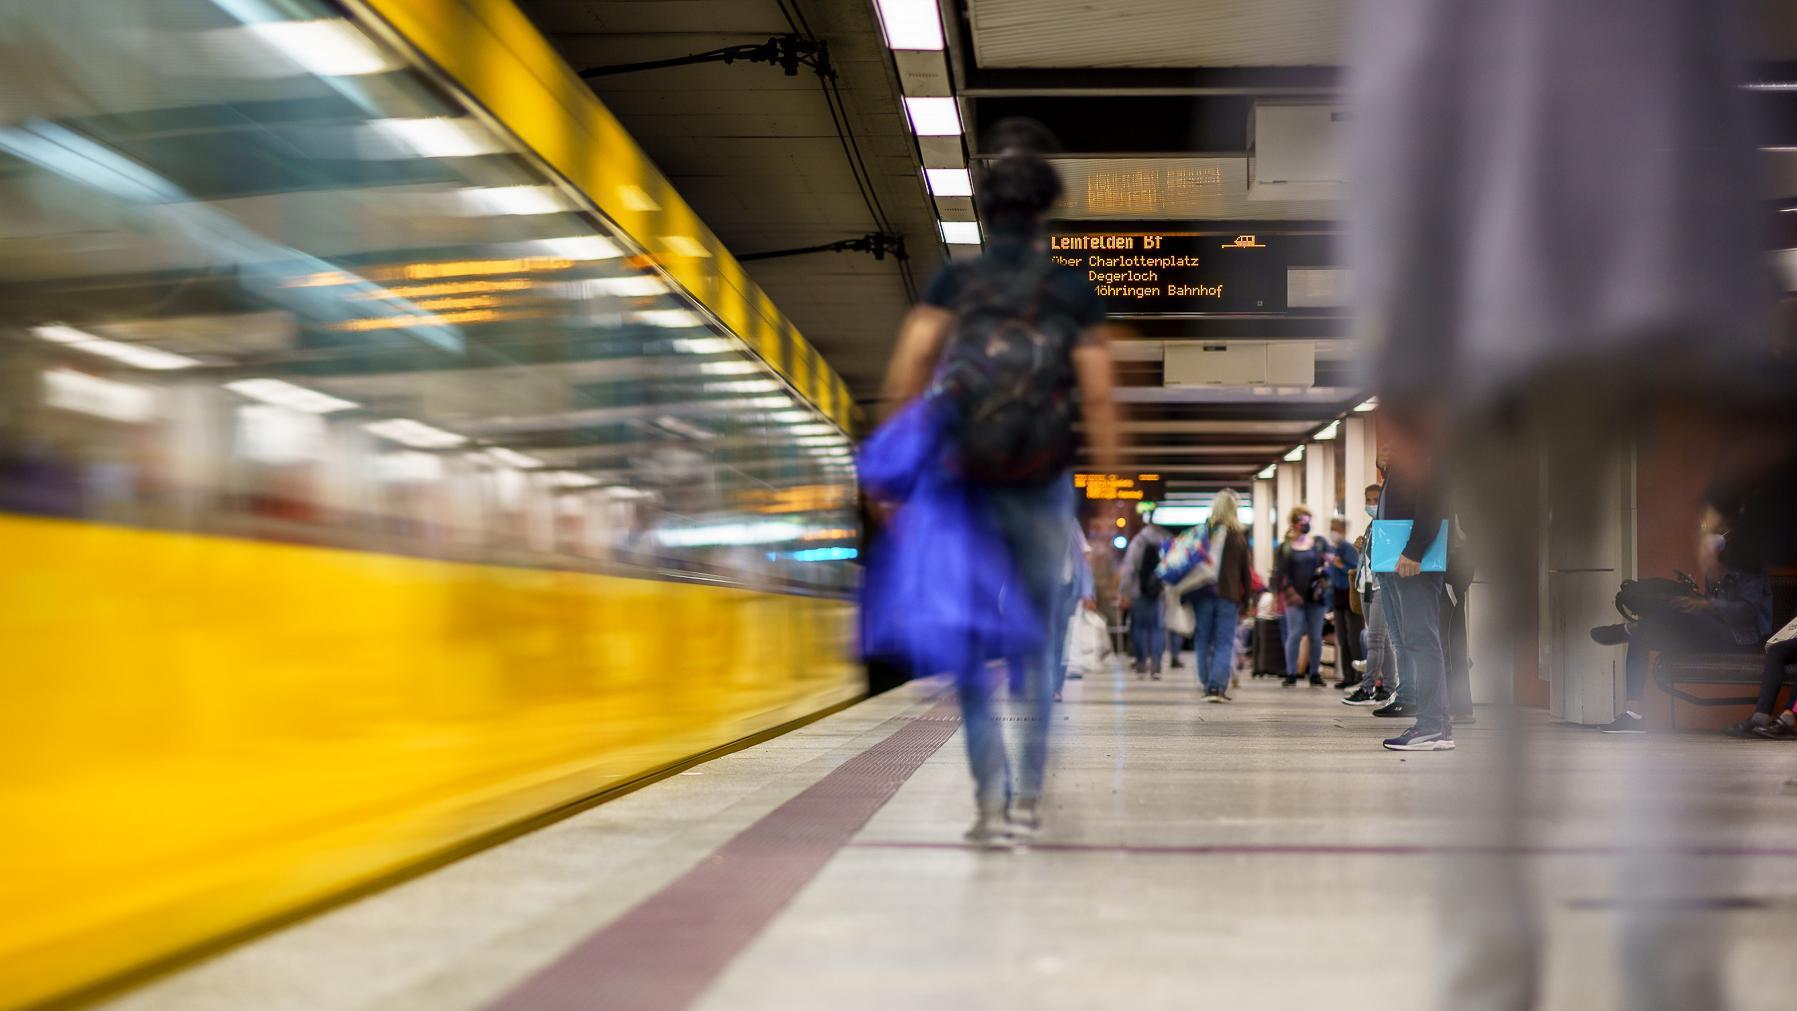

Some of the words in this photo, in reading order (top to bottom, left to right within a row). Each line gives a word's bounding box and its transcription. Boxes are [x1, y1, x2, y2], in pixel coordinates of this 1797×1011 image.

[1051, 235, 1133, 250] Leinfelden
[1143, 235, 1163, 250] Bf
[1088, 255, 1199, 268] Charlottenplatz
[1088, 270, 1158, 283] Degerloch
[1167, 285, 1223, 298] Bahnhof
